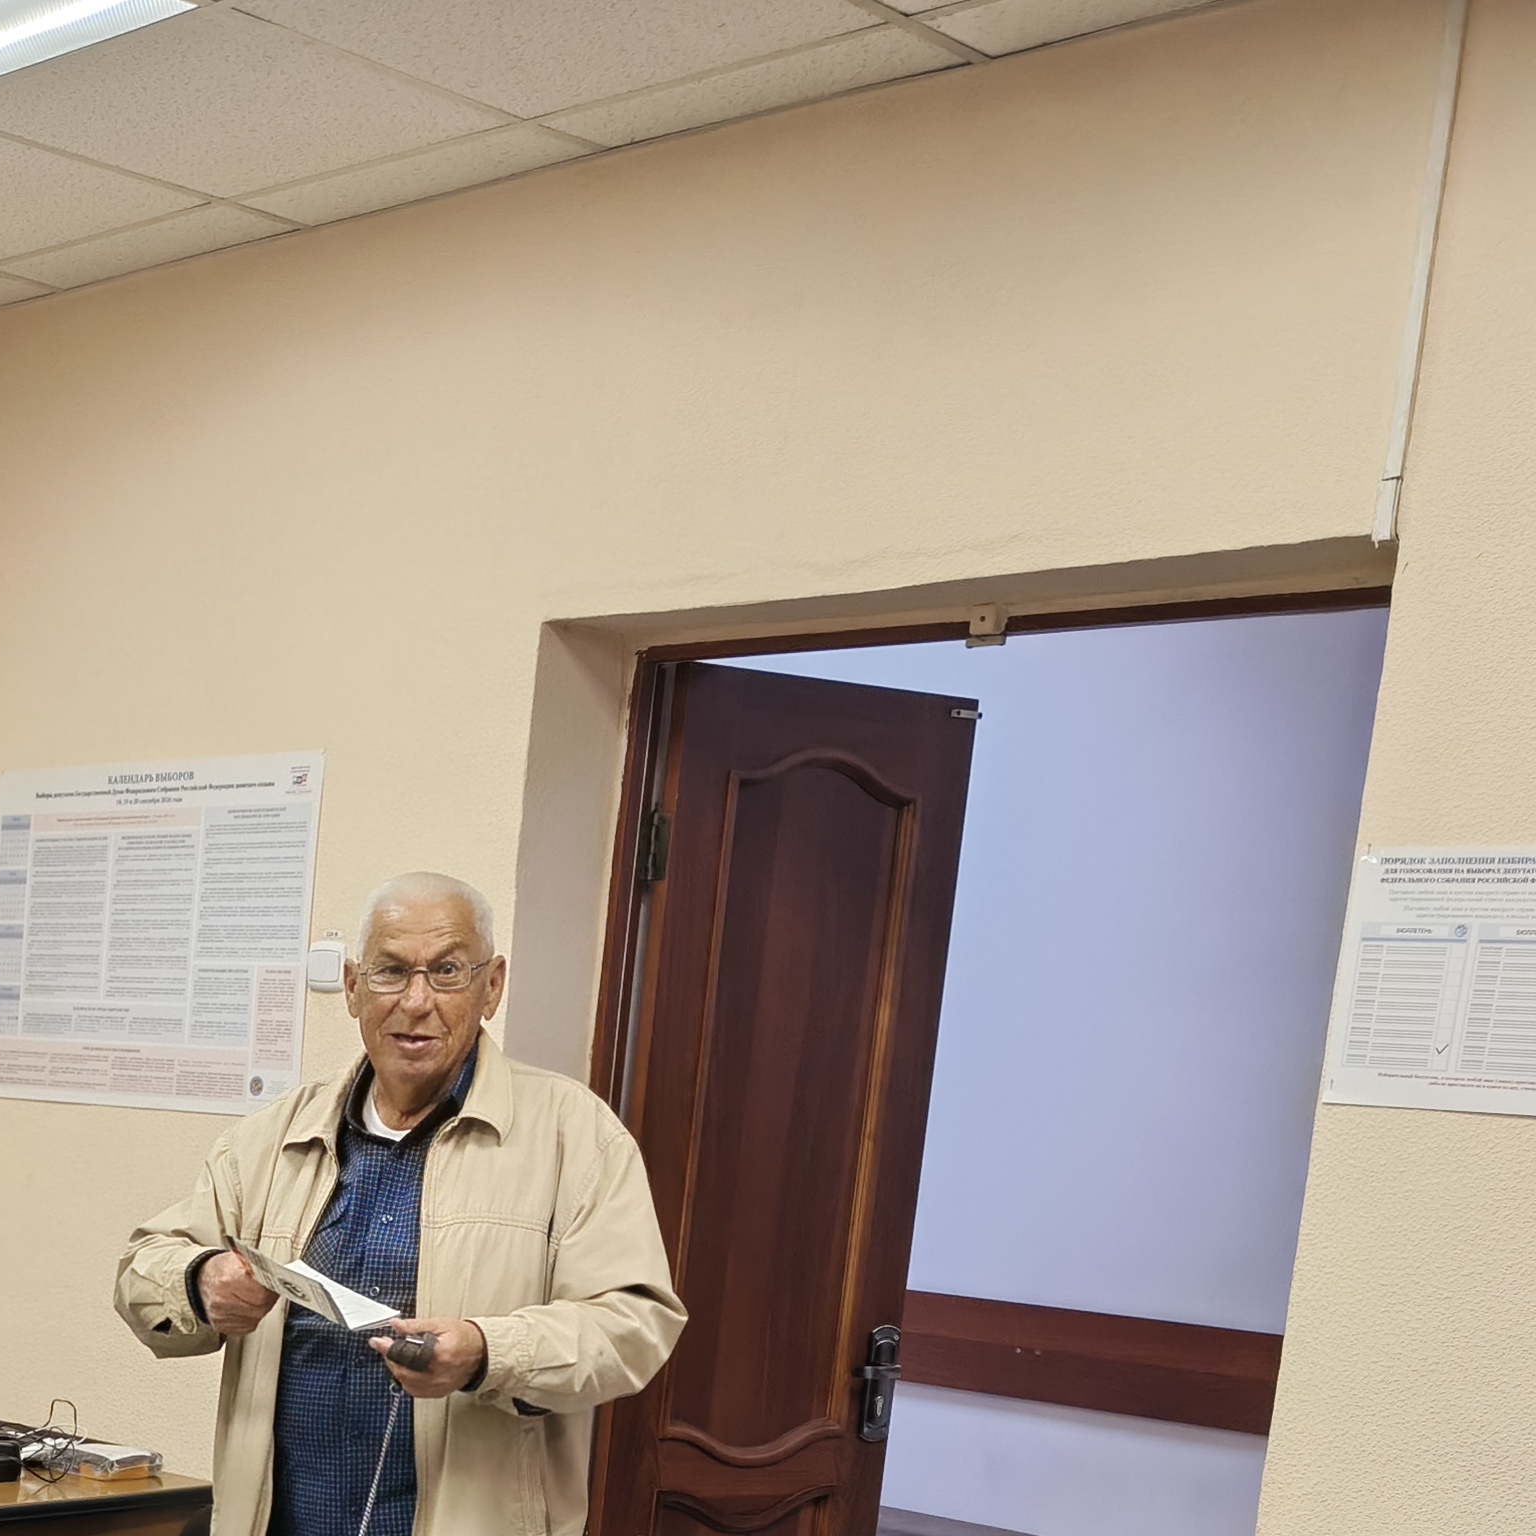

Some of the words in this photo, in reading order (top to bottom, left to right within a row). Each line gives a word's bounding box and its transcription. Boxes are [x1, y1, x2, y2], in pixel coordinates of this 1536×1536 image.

[107, 773, 154, 785] КАЛЕНДАРЬ
[155, 771, 195, 783] ВЫБОРОВ
[1380, 857, 1427, 865] ПОРЯДОК
[1428, 857, 1495, 865] ЗАПОЛНЕНИЯ
